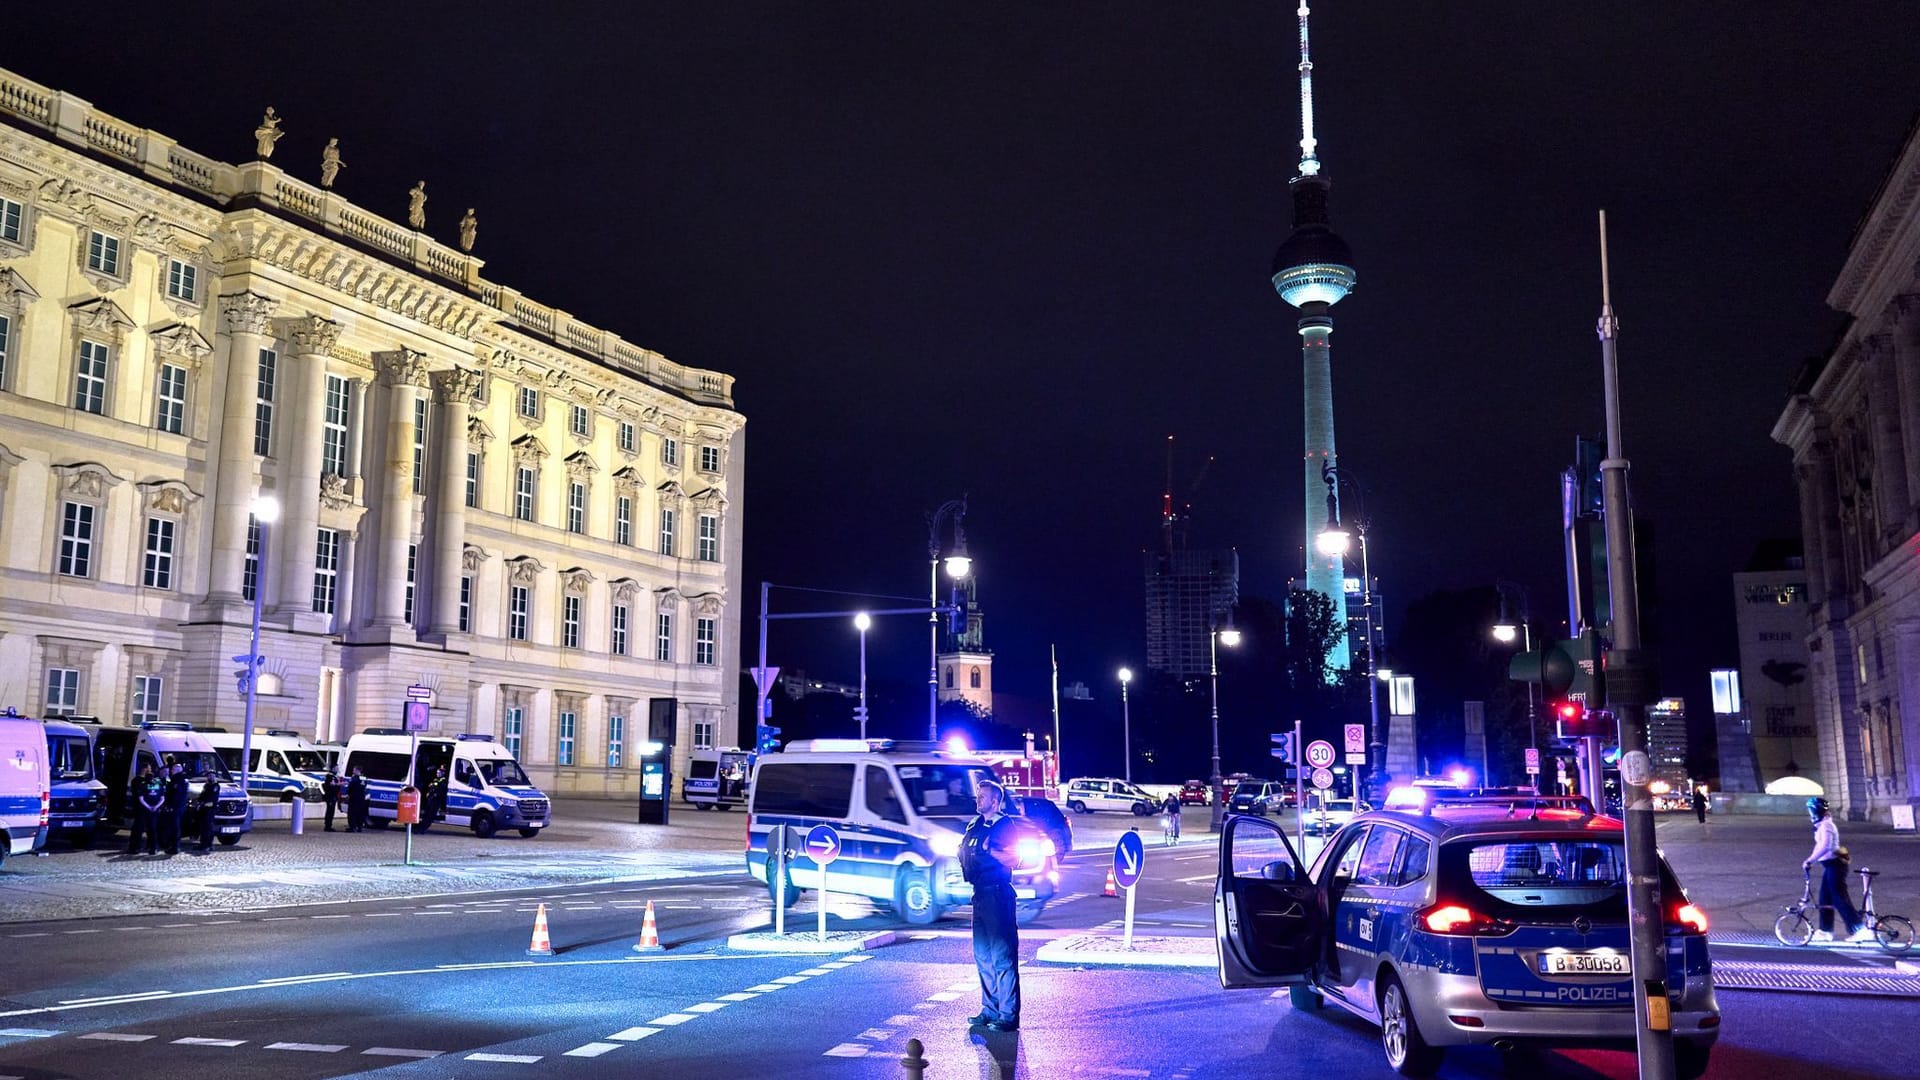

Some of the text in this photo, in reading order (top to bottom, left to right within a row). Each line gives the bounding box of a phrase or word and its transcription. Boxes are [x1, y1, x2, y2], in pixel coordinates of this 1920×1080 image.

[1312, 748, 1329, 761] 30
[1001, 775, 1020, 786] 112
[1556, 956, 1622, 971] B 30058
[1557, 987, 1617, 1001] POLIZEI
